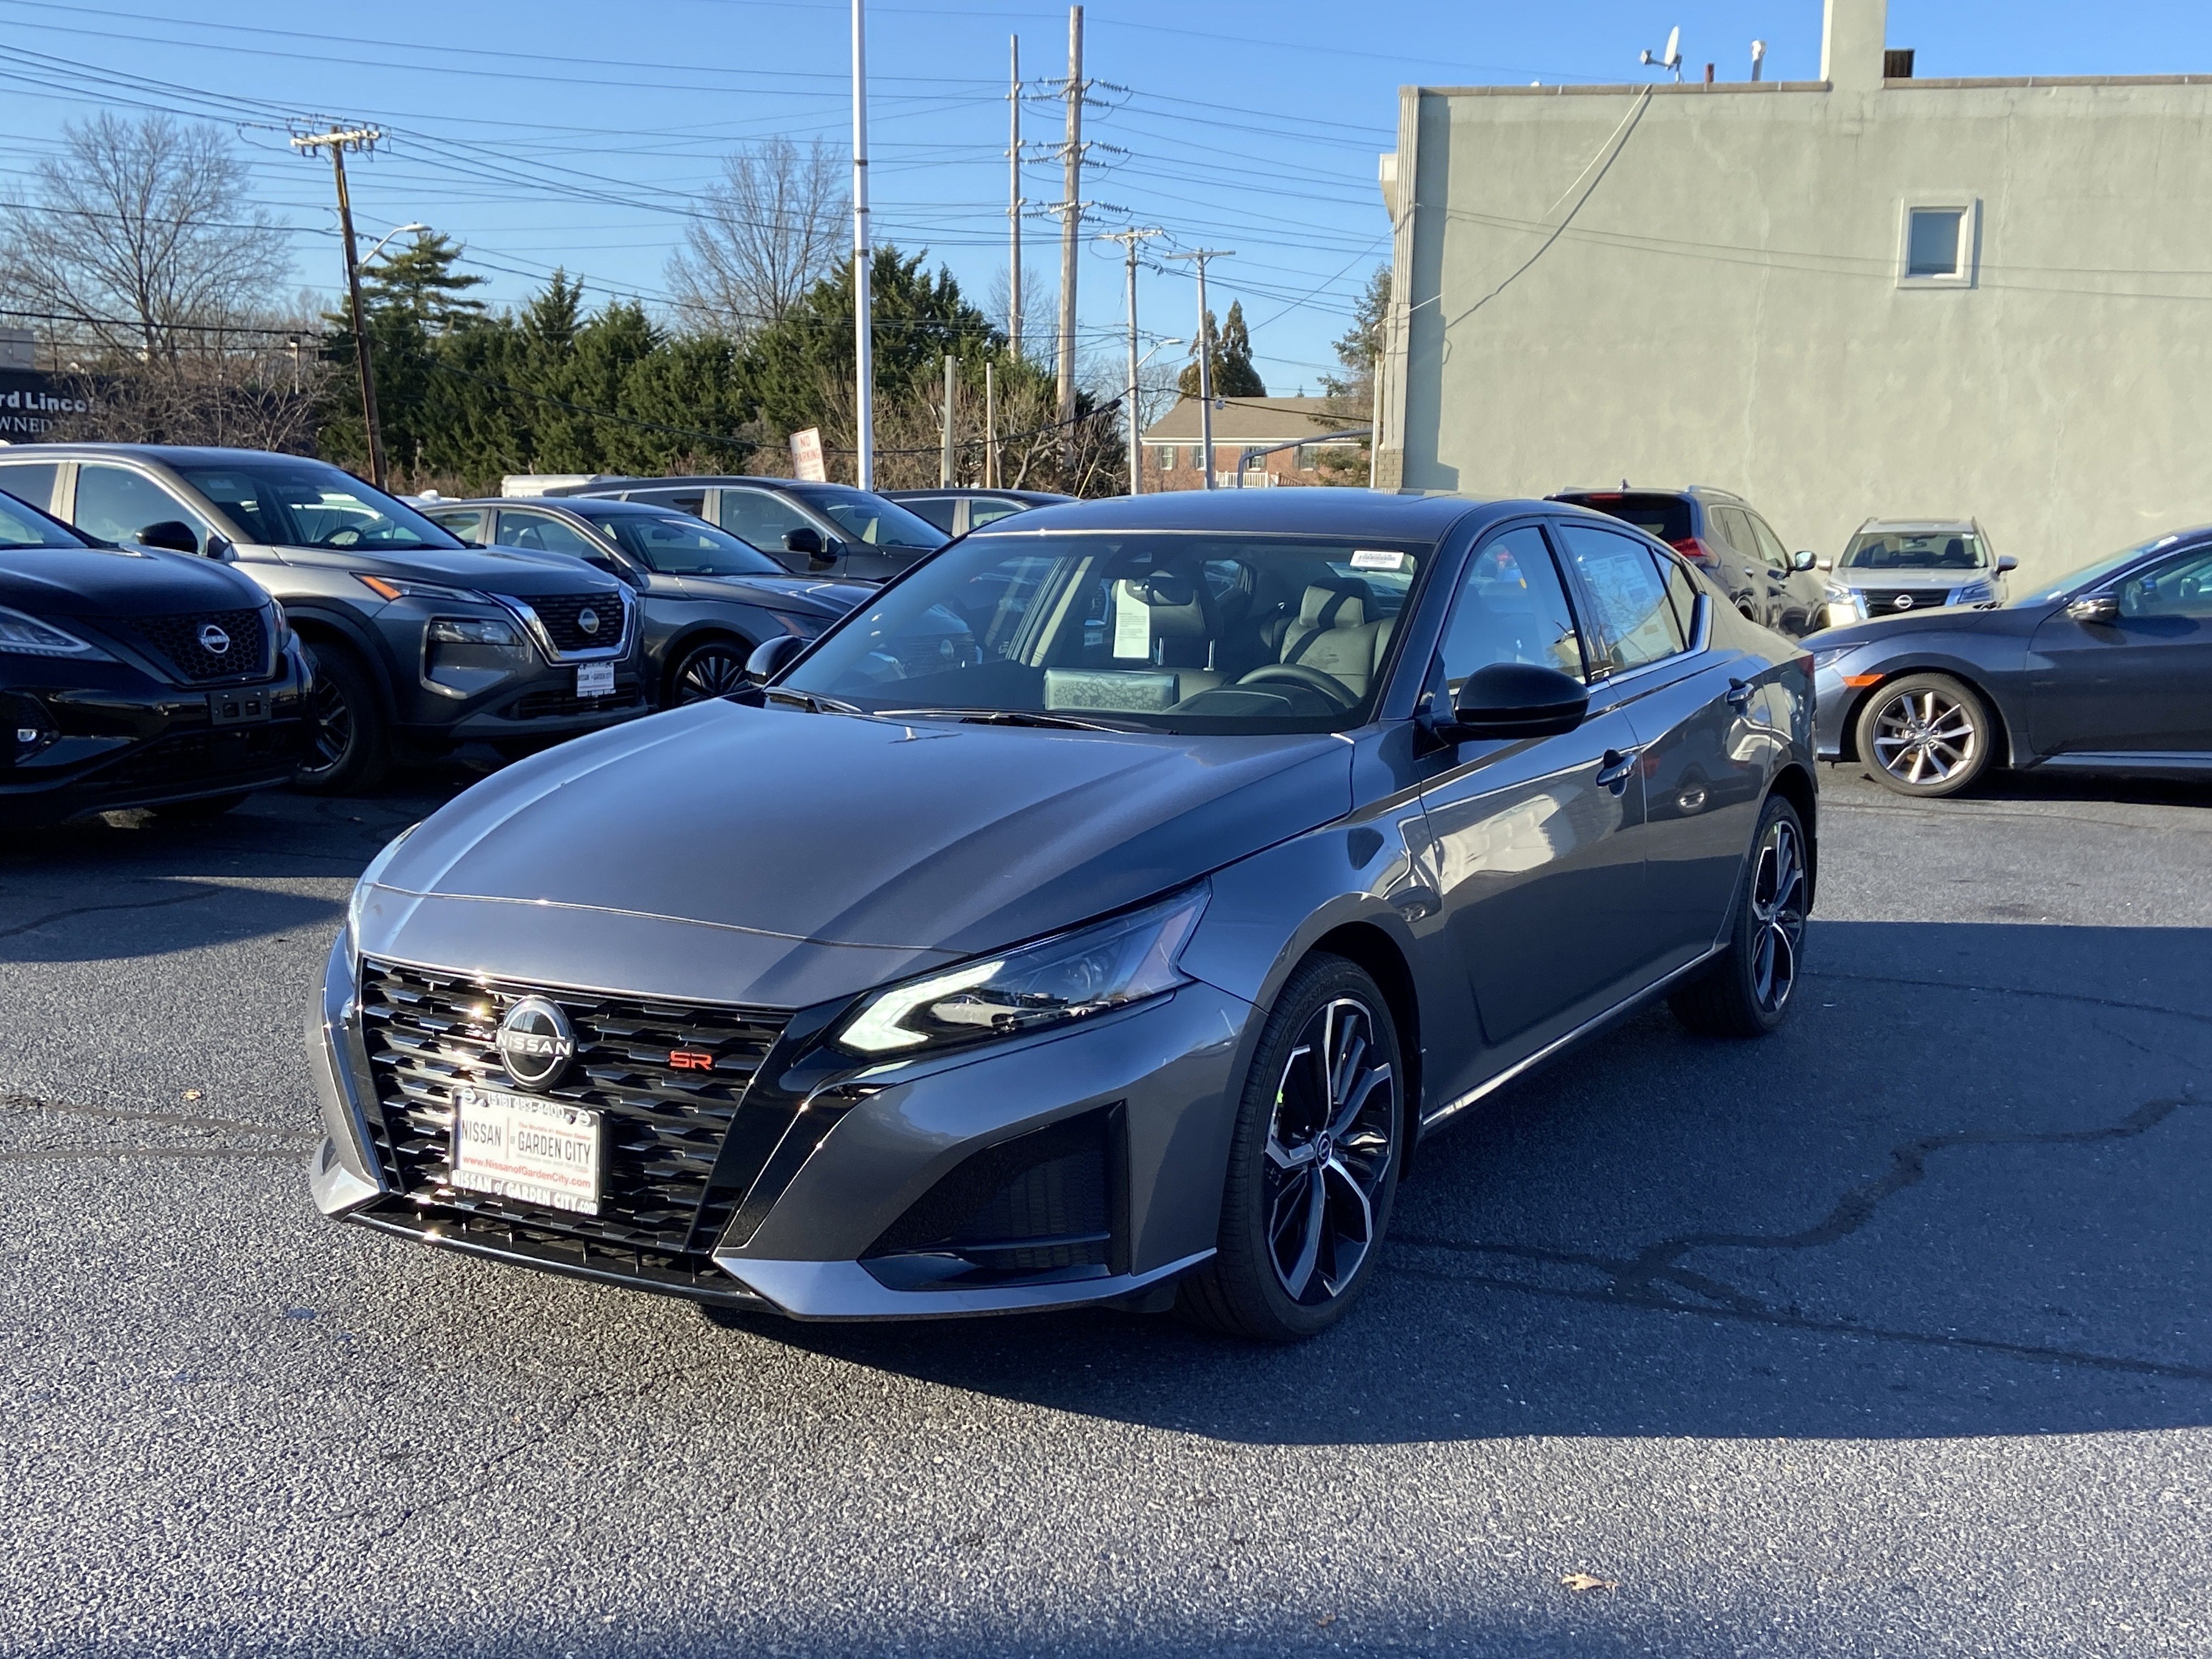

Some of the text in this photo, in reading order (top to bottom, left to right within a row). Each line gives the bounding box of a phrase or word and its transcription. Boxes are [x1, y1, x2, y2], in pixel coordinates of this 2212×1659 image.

[25, 392, 94, 413] Linco
[496, 1031, 572, 1056] NISSAN
[669, 1049, 713, 1070] SR
[461, 1119, 502, 1147] NISSAN
[518, 1131, 562, 1160] GARDEN
[565, 1141, 591, 1164] CITY
[462, 1155, 591, 1189] www.NissanofGardenCity.com
[452, 1169, 493, 1193] NISSAN
[494, 1180, 505, 1195] of
[506, 1182, 551, 1206] GARDEN
